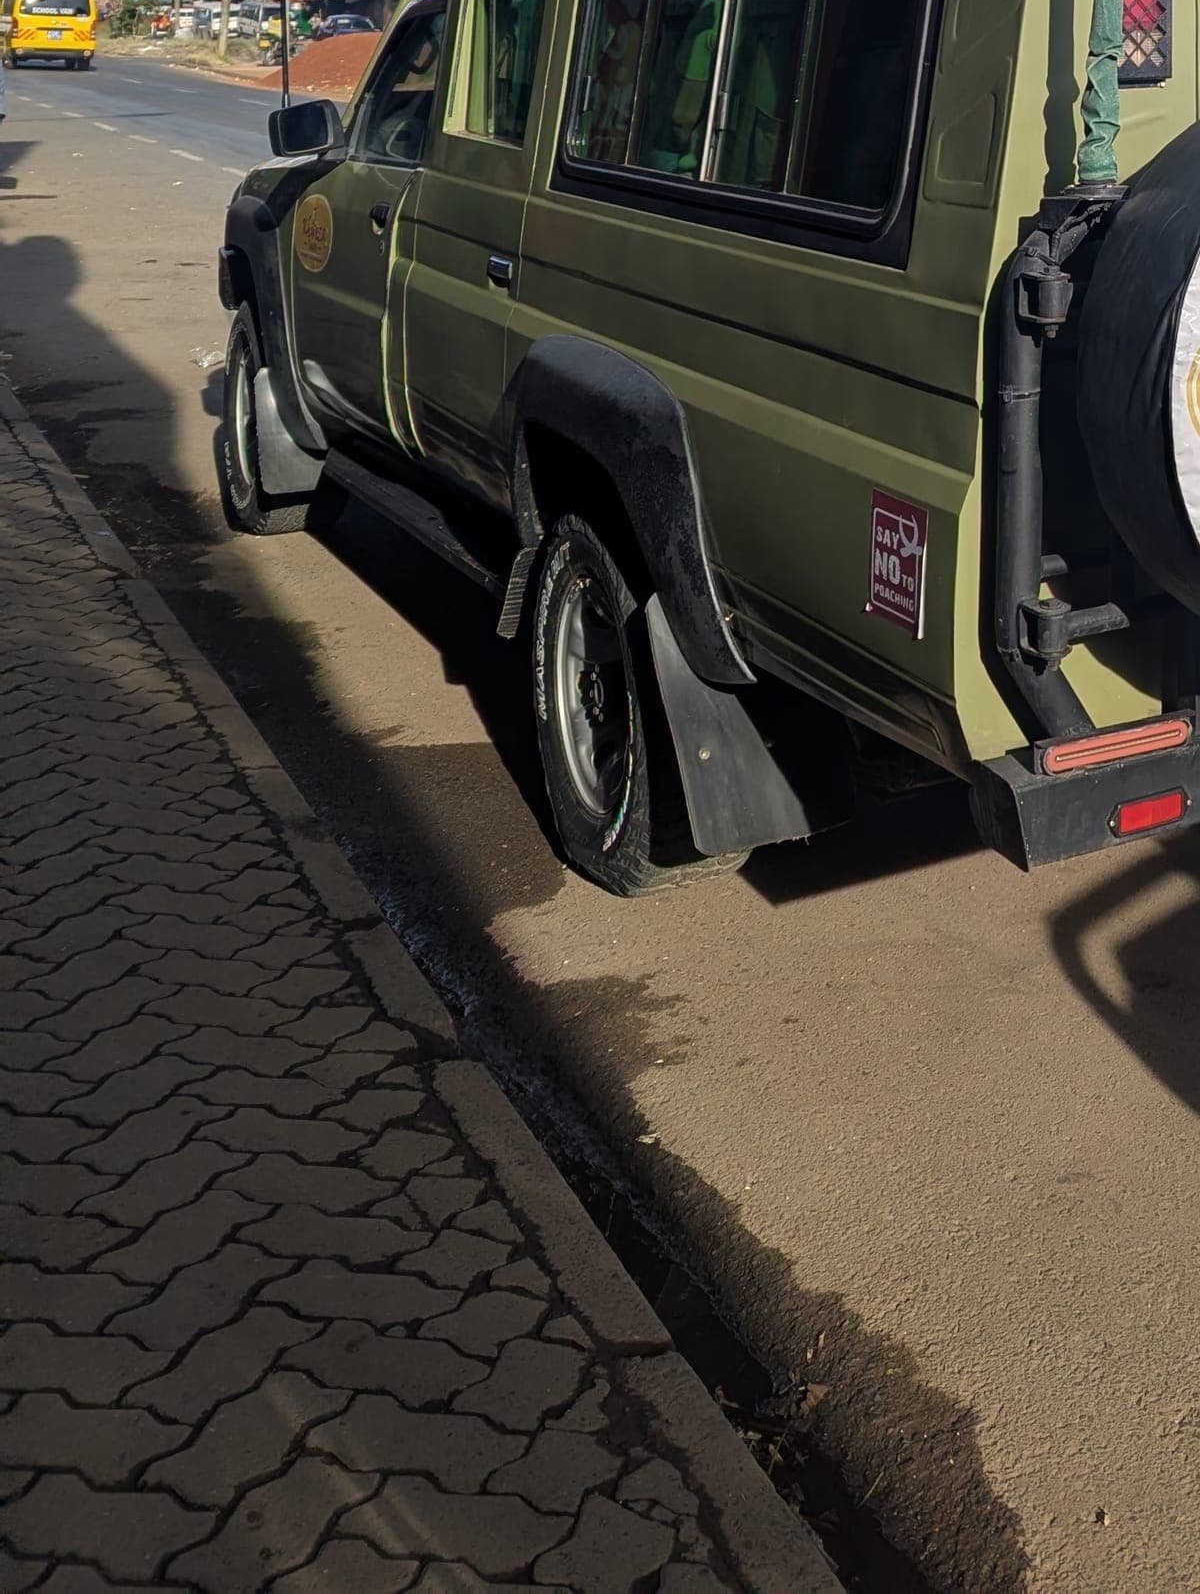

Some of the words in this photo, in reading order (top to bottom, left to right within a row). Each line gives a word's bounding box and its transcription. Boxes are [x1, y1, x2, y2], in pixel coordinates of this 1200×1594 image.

[875, 525, 900, 550] SAY
[874, 547, 901, 586] NO
[901, 573, 915, 593] TO
[874, 582, 915, 612] POACHING
